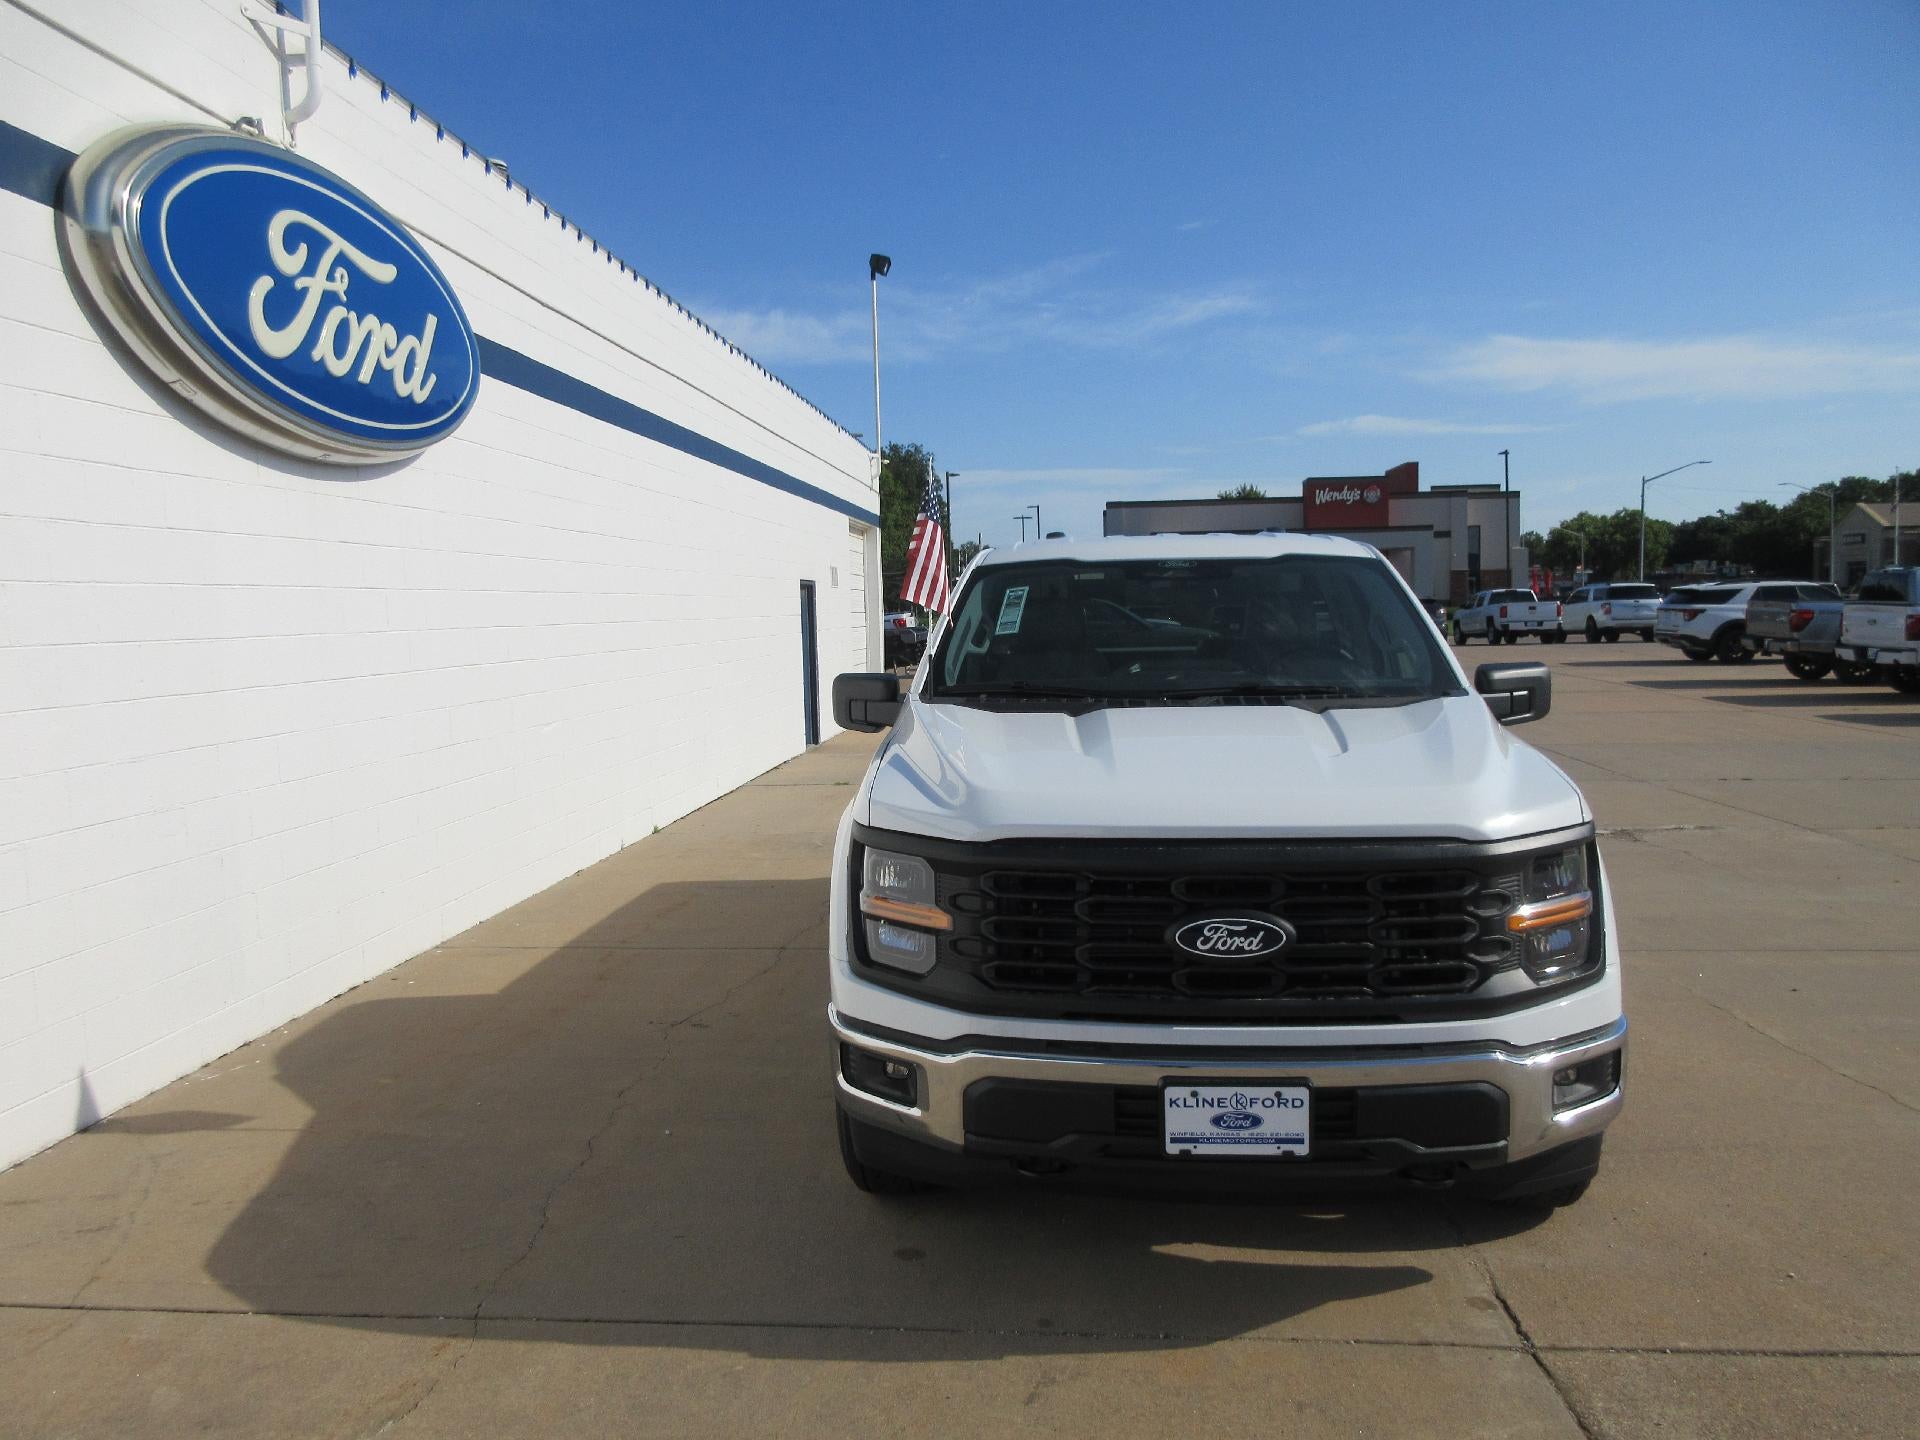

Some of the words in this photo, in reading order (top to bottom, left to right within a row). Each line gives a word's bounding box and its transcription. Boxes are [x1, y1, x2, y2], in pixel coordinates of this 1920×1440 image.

[248, 209, 437, 404] Ford
[1315, 485, 1361, 504] Wendy's
[1196, 923, 1265, 951] Ford
[1169, 1097, 1227, 1109] KLINE
[1249, 1097, 1304, 1109] FORD
[1220, 1114, 1252, 1127] Ford
